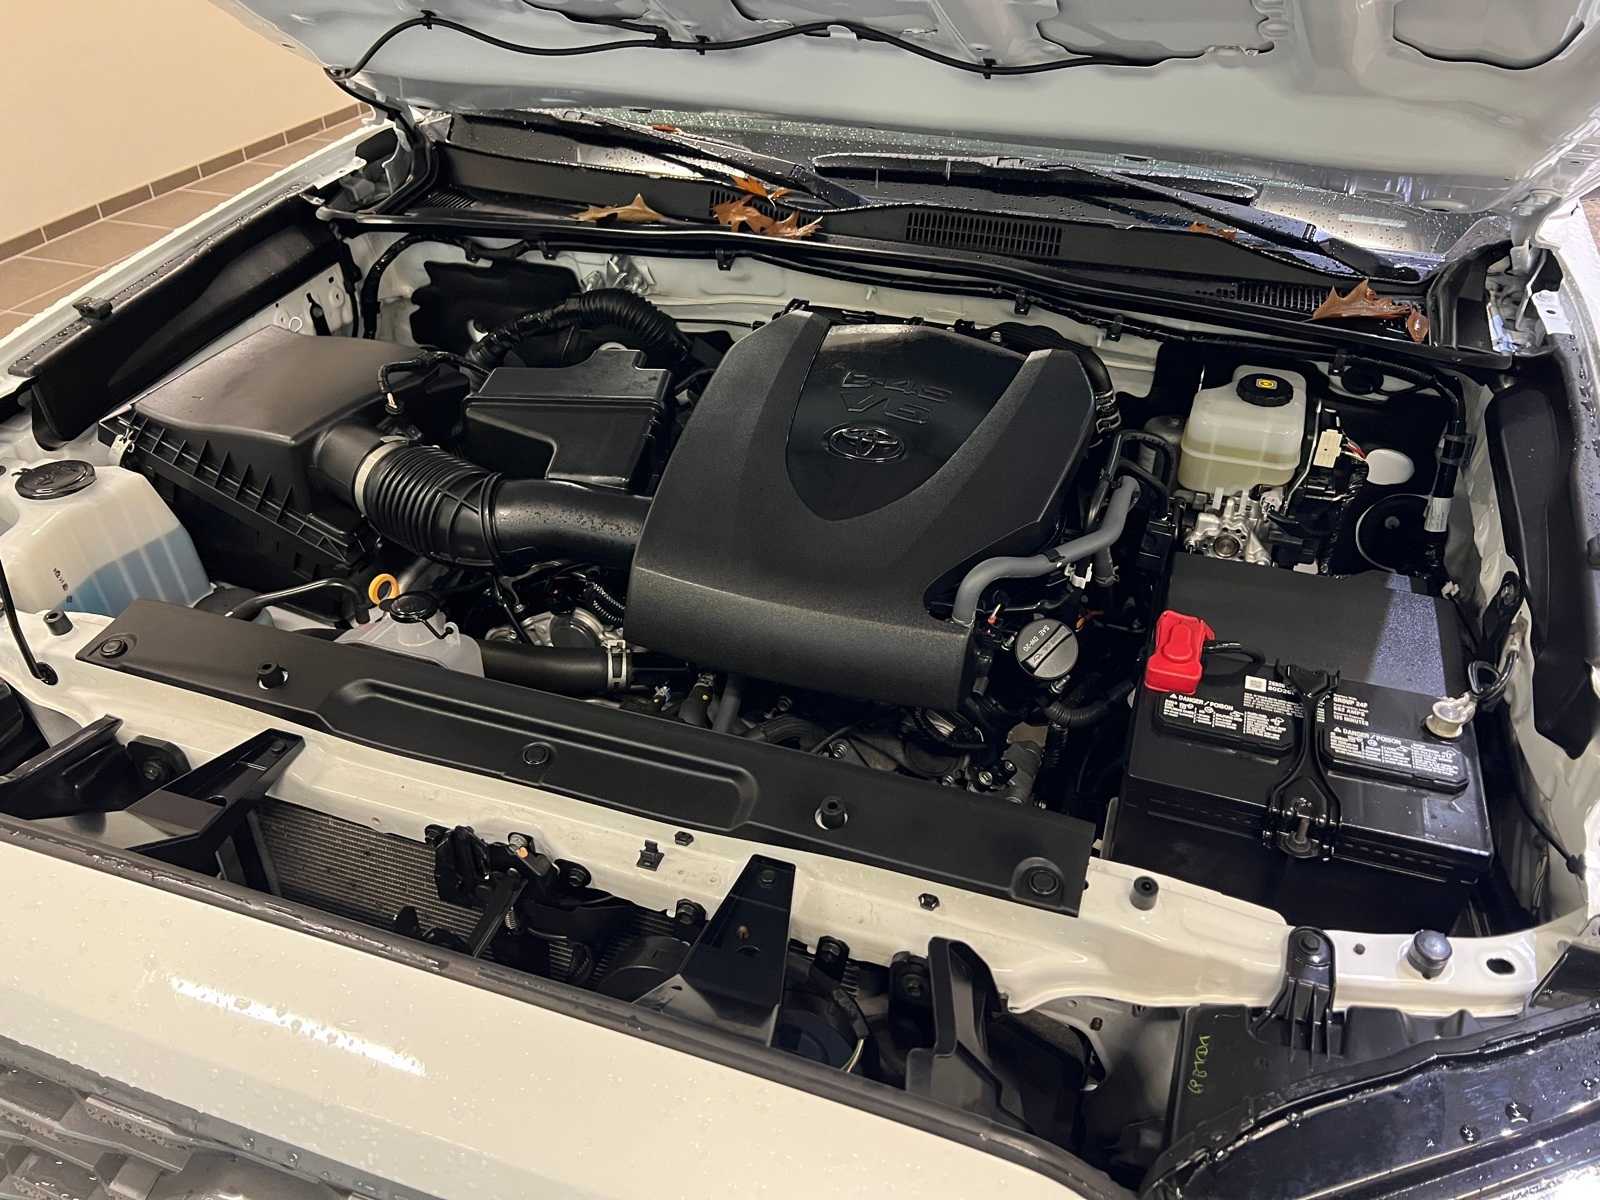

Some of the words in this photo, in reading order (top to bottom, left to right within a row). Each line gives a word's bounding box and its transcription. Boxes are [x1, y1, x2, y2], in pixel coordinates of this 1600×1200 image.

[840, 390, 933, 425] V6
[1038, 625, 1050, 636] SAE
[1178, 695, 1204, 705] DANGER
[1210, 701, 1234, 711] POISON
[1333, 696, 1355, 705] GROUP
[1347, 709, 1366, 717] AMPS
[1344, 716, 1369, 726] MINUTES
[1343, 728, 1370, 738] DANGER
[1376, 736, 1402, 745] POISON
